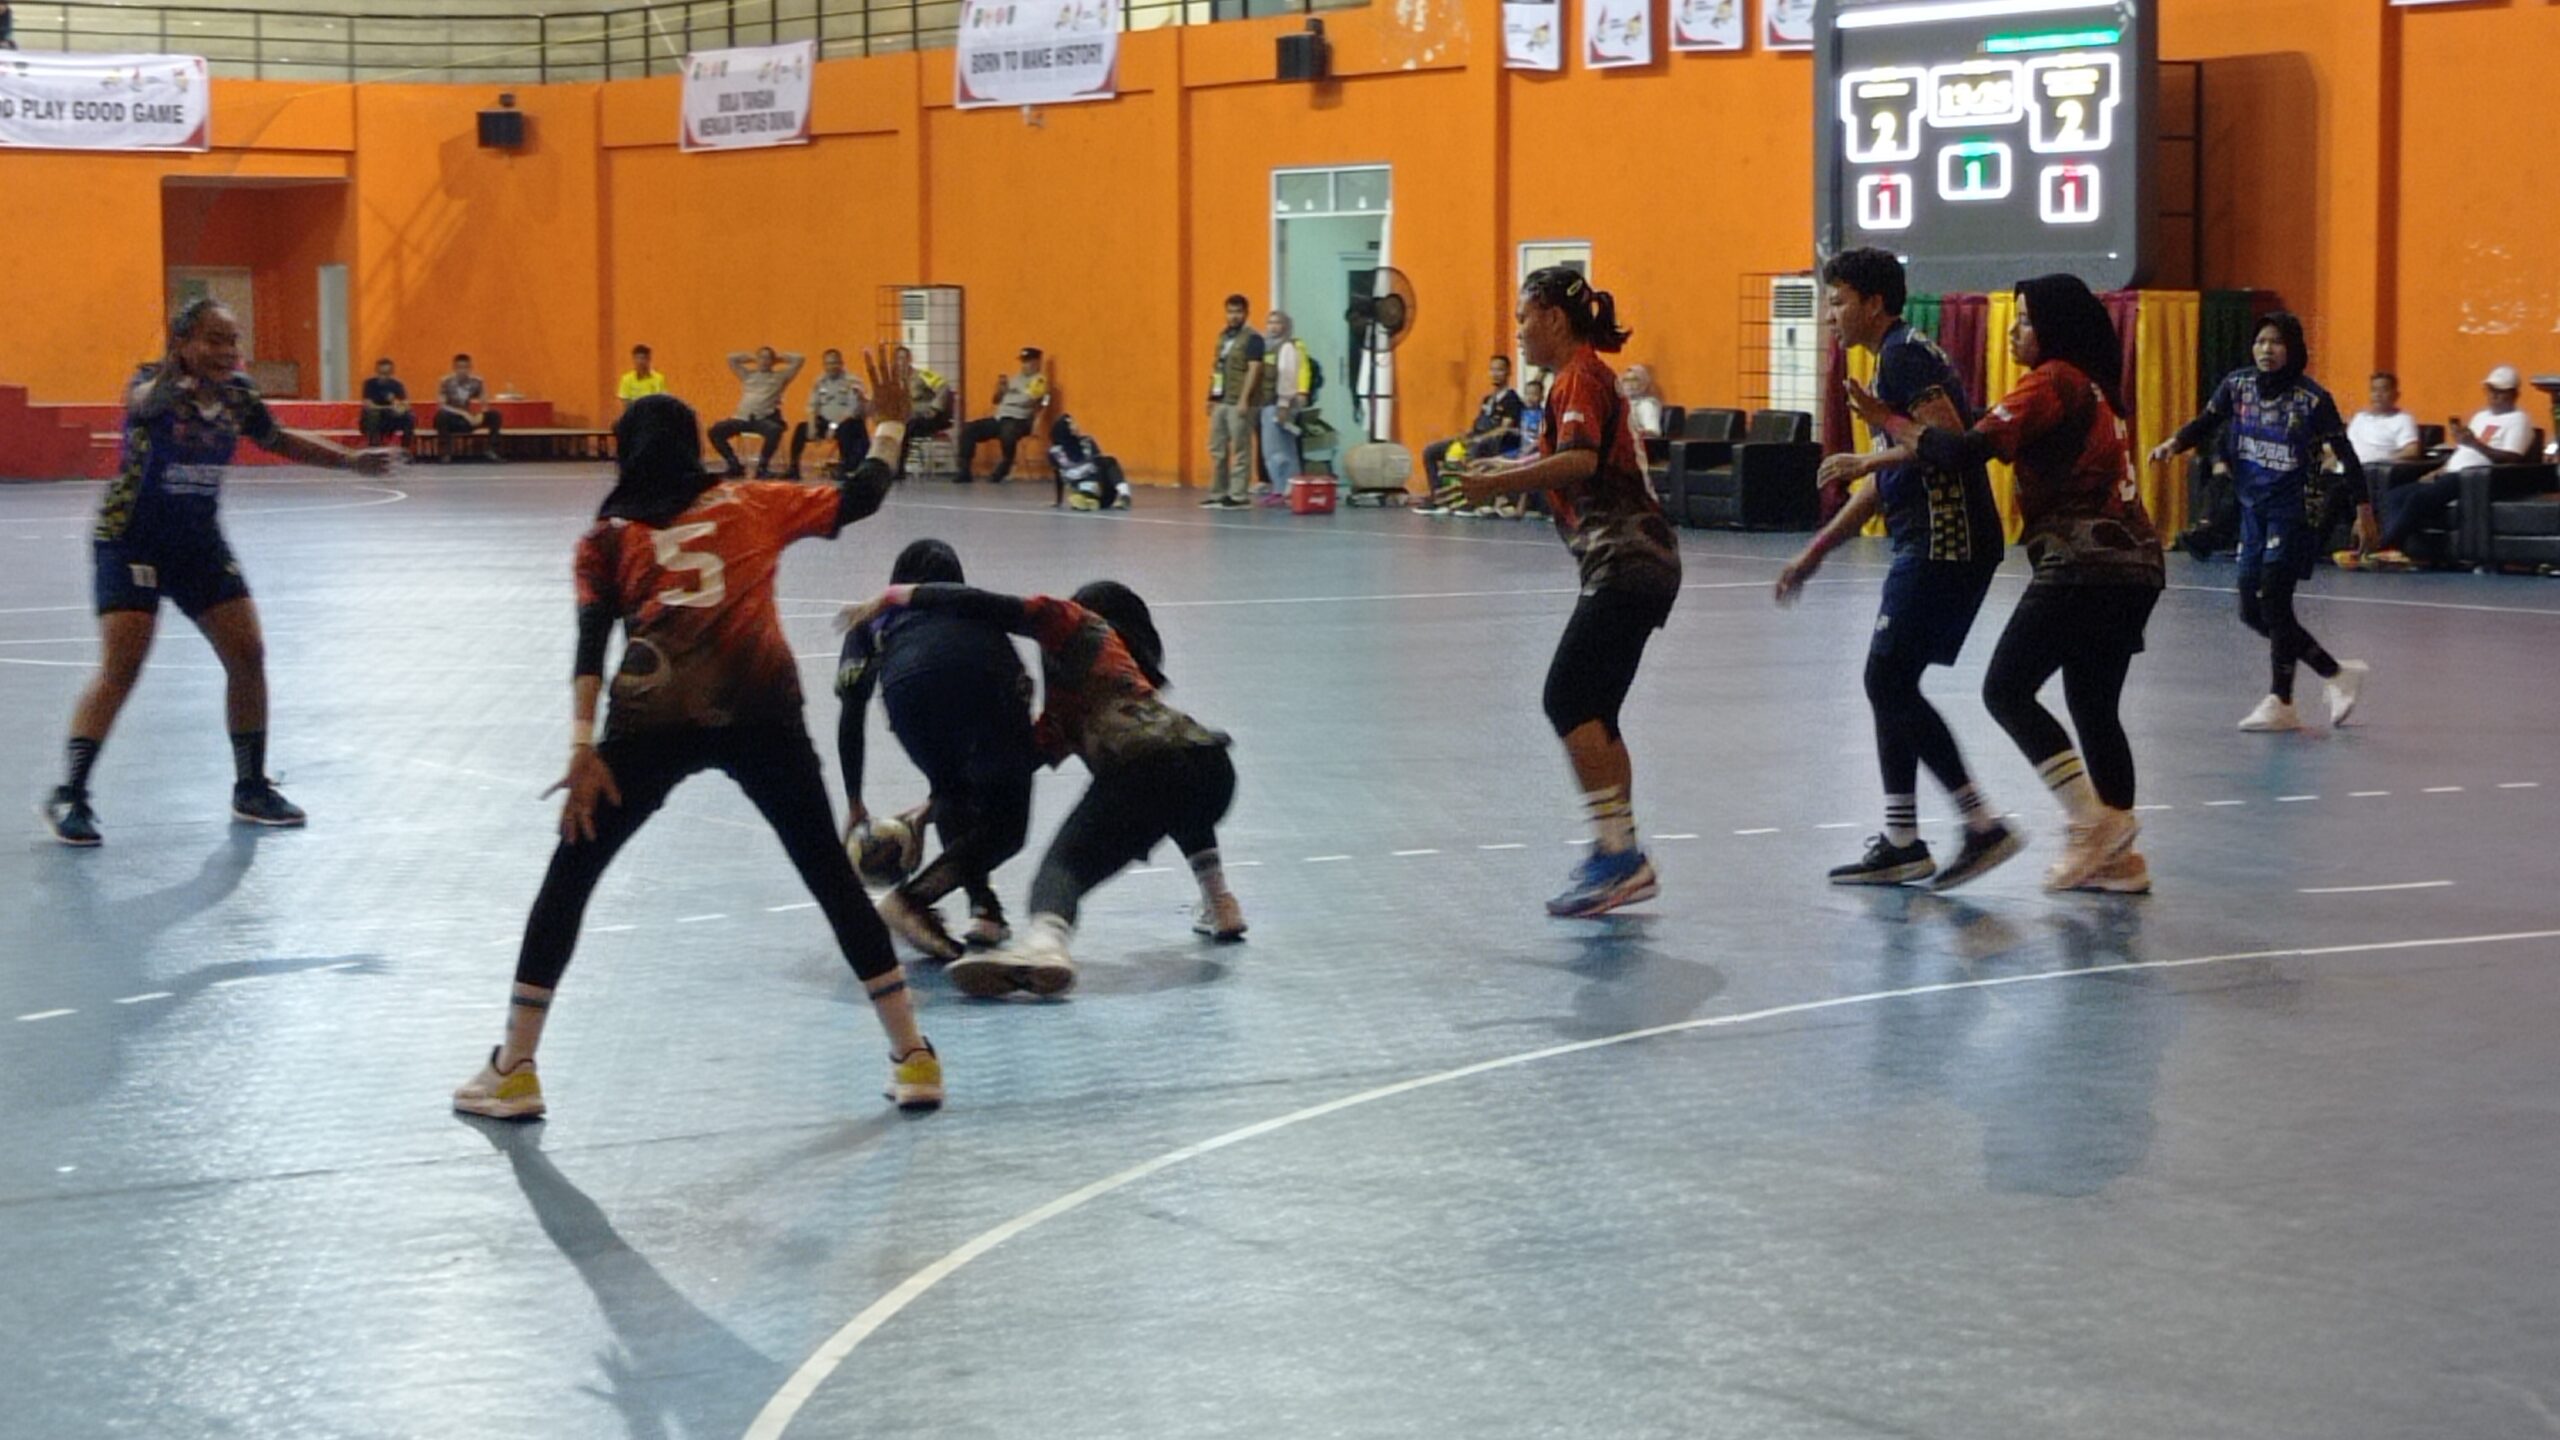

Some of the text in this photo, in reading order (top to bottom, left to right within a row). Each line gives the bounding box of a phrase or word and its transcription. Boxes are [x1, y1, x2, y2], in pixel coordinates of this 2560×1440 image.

[22, 99, 65, 120] PLAY
[73, 101, 125, 122] GOOD
[132, 103, 184, 124] GAME
[651, 521, 726, 608] 5
